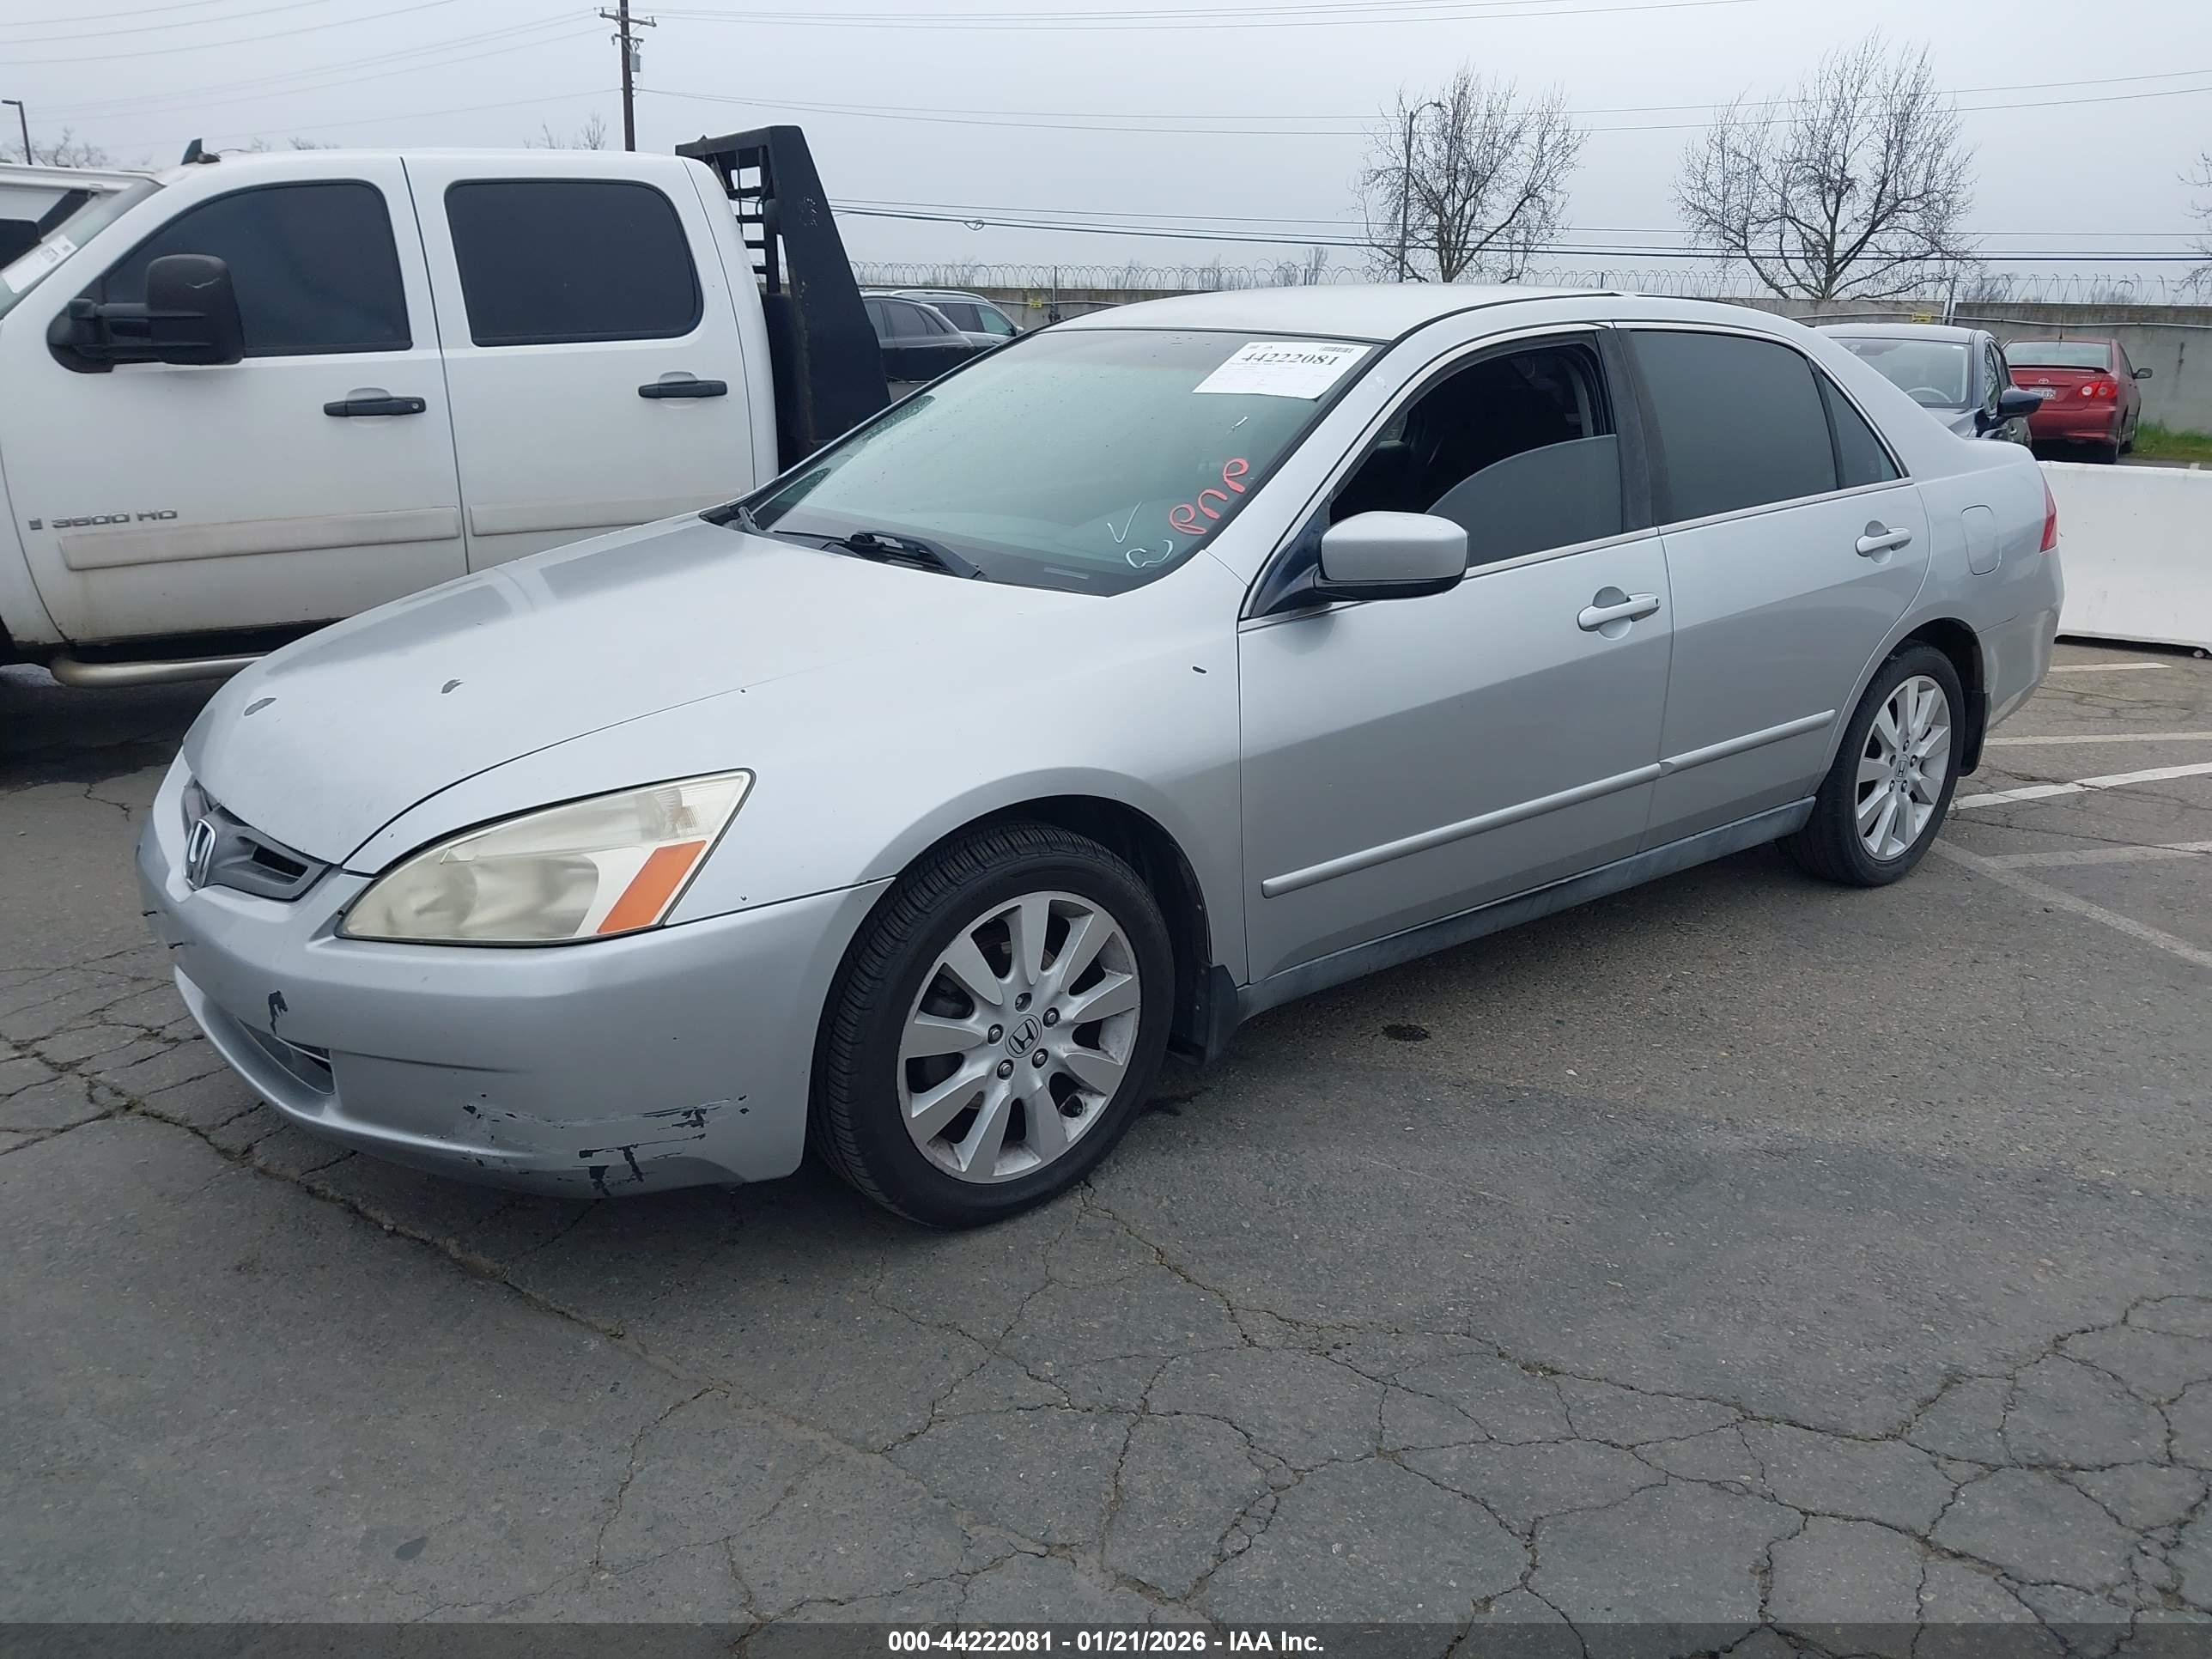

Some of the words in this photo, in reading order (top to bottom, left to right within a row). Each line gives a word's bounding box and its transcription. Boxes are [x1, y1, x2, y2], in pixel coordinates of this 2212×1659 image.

[1241, 351, 1340, 366] 44222081
[52, 512, 130, 529] 3500
[136, 508, 178, 521] HD
